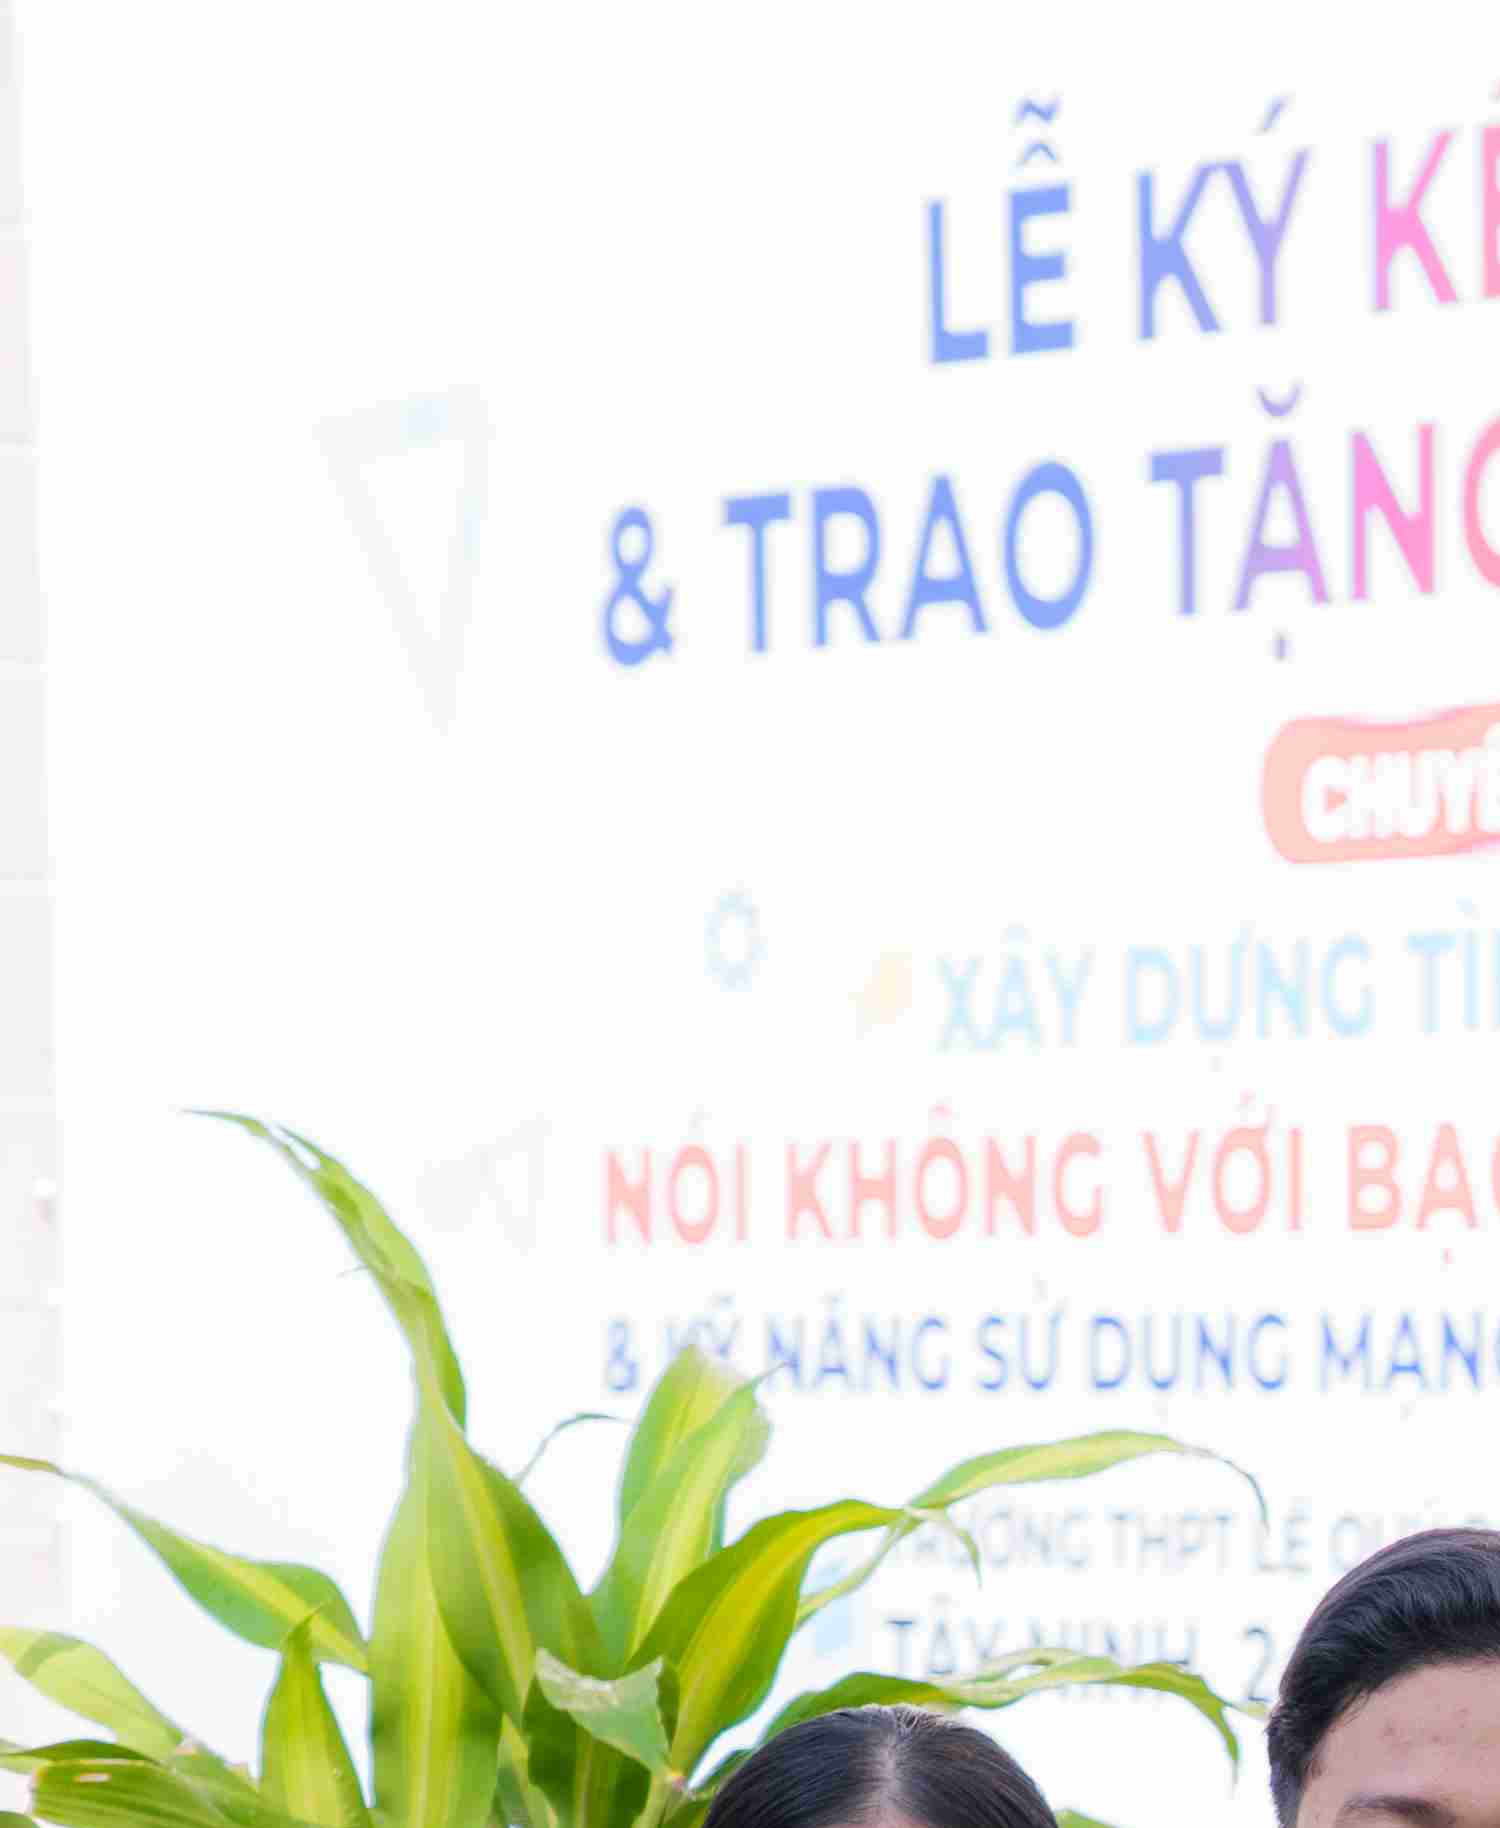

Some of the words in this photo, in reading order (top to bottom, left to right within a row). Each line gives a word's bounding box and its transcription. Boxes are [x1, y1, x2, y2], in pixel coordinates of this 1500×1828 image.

[924, 96, 1077, 364] LỄ
[1134, 93, 1310, 342] KÝ
[599, 505, 676, 667] &
[720, 458, 1096, 654] TRAO
[938, 925, 1094, 1053] XÂY
[1125, 927, 1374, 1070] DỰNG
[602, 1112, 749, 1246] NÓI
[787, 1102, 1104, 1242] KHÔNG
[1141, 1090, 1306, 1237] VỚI
[603, 1314, 641, 1393] &
